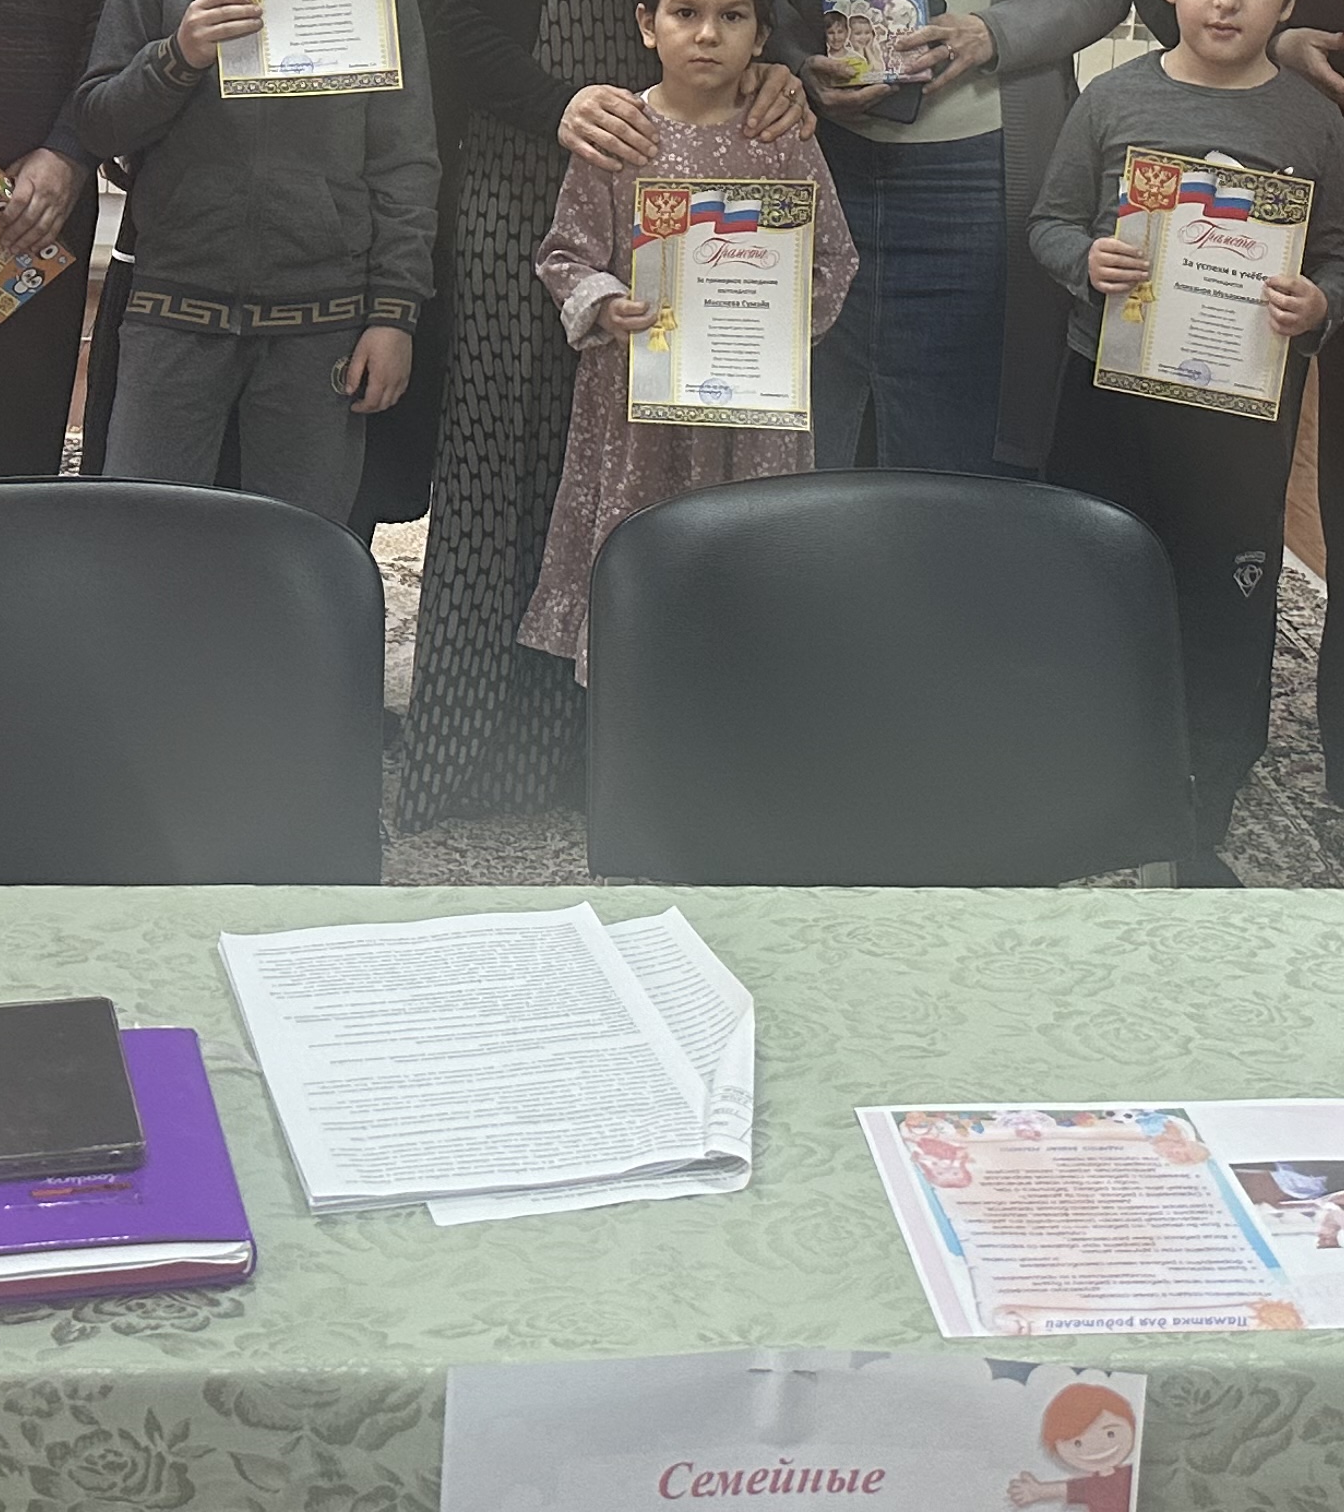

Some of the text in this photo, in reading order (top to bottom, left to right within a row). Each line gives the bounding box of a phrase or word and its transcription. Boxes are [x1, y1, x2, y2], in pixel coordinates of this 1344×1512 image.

[1043, 1316, 1248, 1331] Памятка для родителей
[657, 1457, 887, 1500] Семейные
